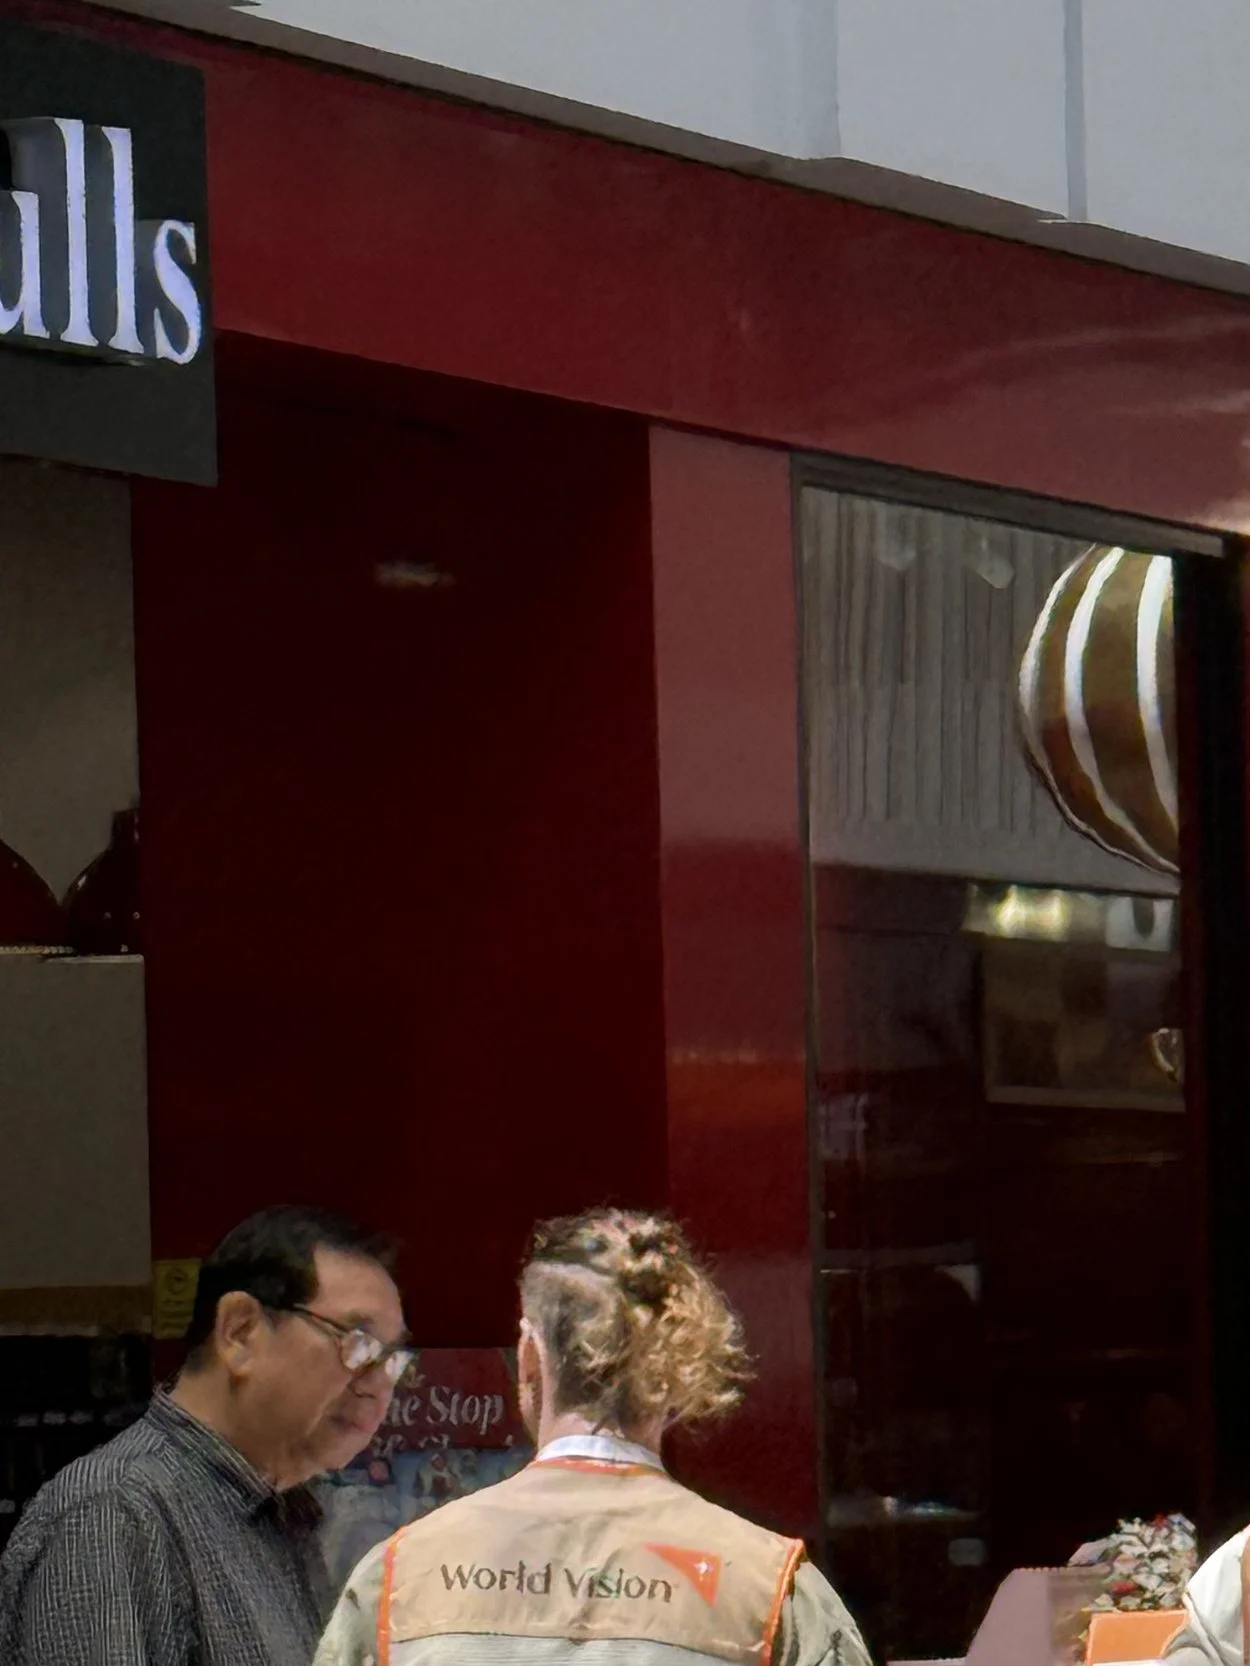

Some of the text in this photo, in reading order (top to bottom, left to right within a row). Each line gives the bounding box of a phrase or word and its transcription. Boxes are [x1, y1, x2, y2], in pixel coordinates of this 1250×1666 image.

[426, 1386, 504, 1436] Stop
[440, 1560, 672, 1603] World Vision
